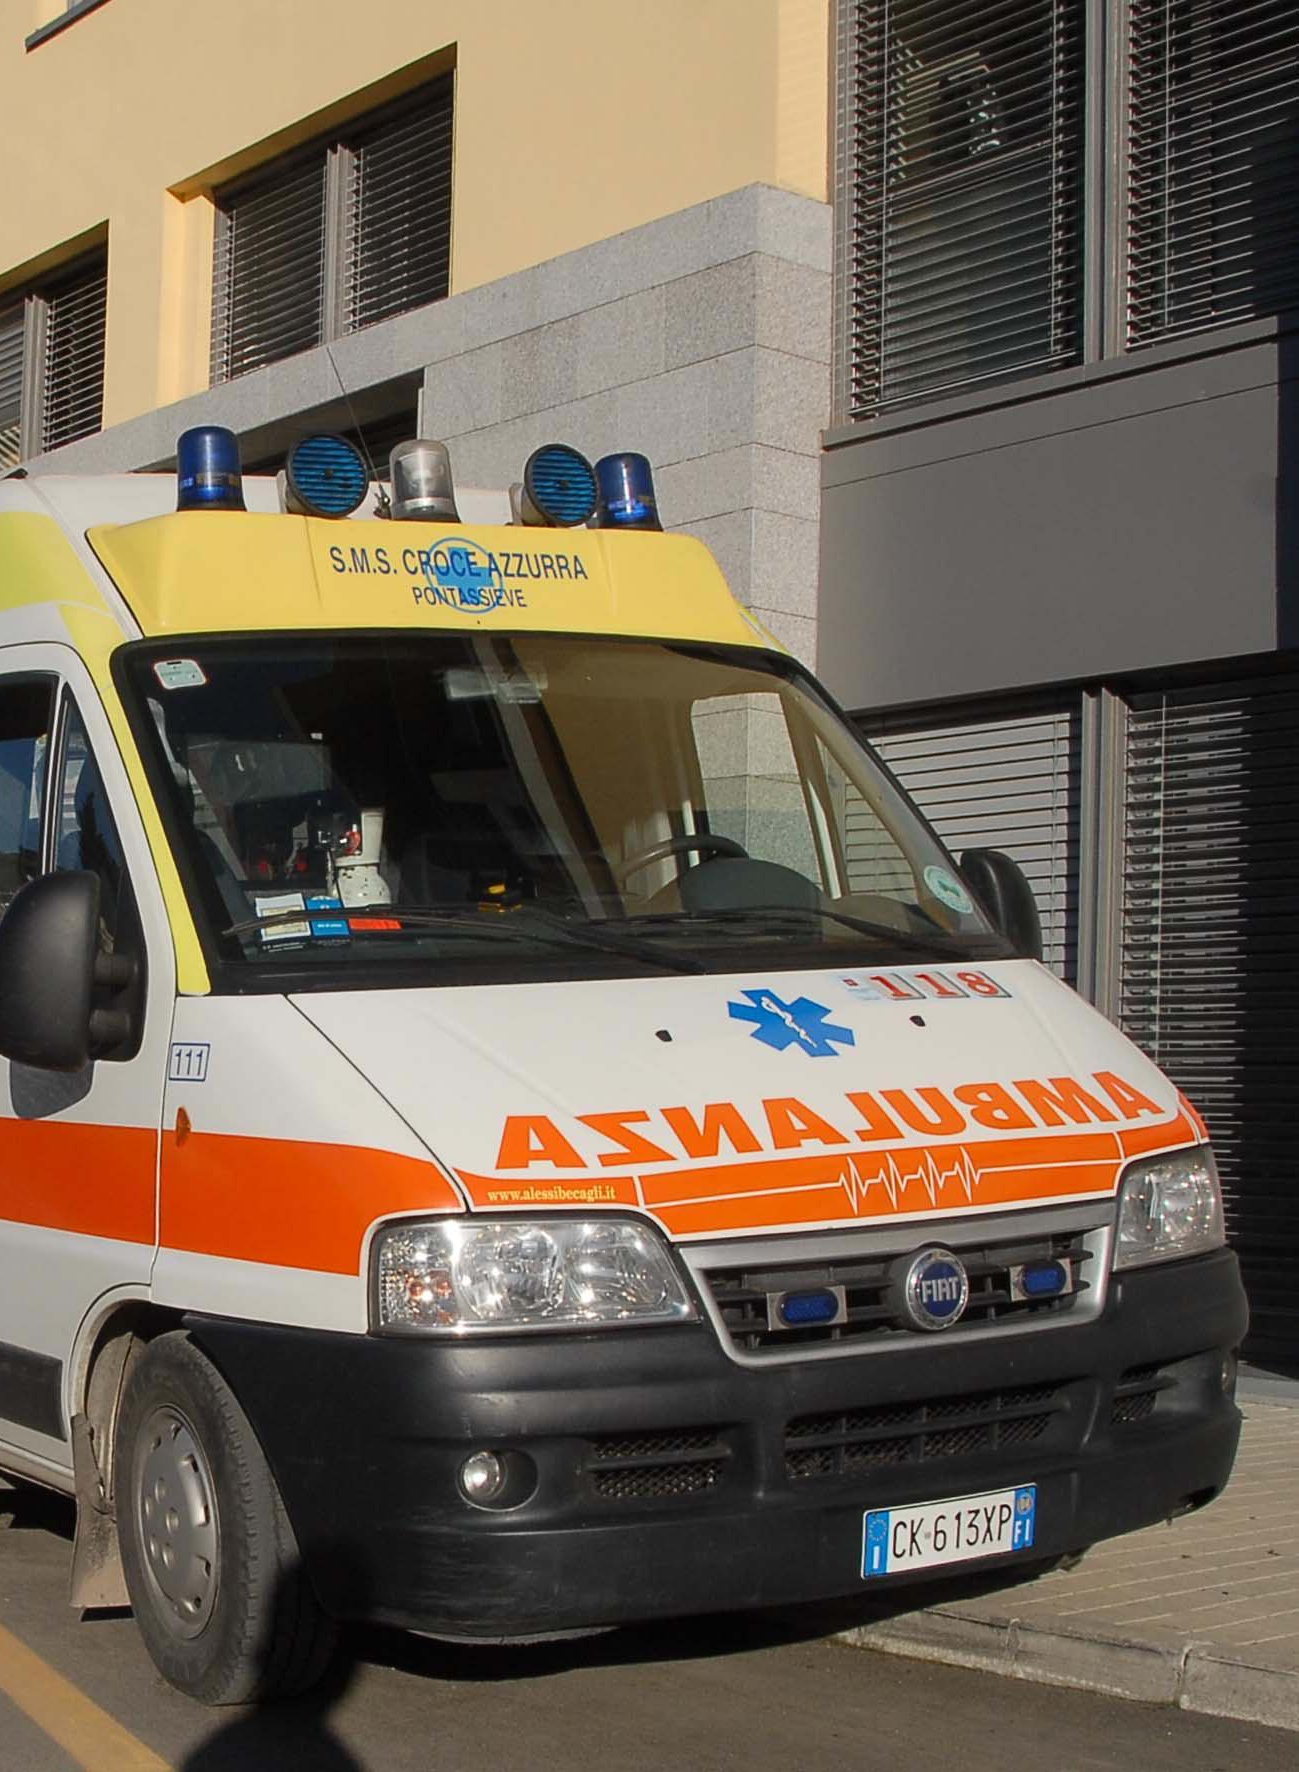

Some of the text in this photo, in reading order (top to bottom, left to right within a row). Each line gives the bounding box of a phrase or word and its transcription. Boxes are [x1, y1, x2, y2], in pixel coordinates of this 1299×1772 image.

[328, 546, 589, 580] S.M.S. CROCE AZZURRA
[411, 586, 528, 608] PONTASSIEVE
[869, 971, 1000, 998] 118
[175, 1048, 204, 1076] 111
[487, 1185, 617, 1203] www.alessibecagli.it
[921, 1276, 959, 1303] FIAT
